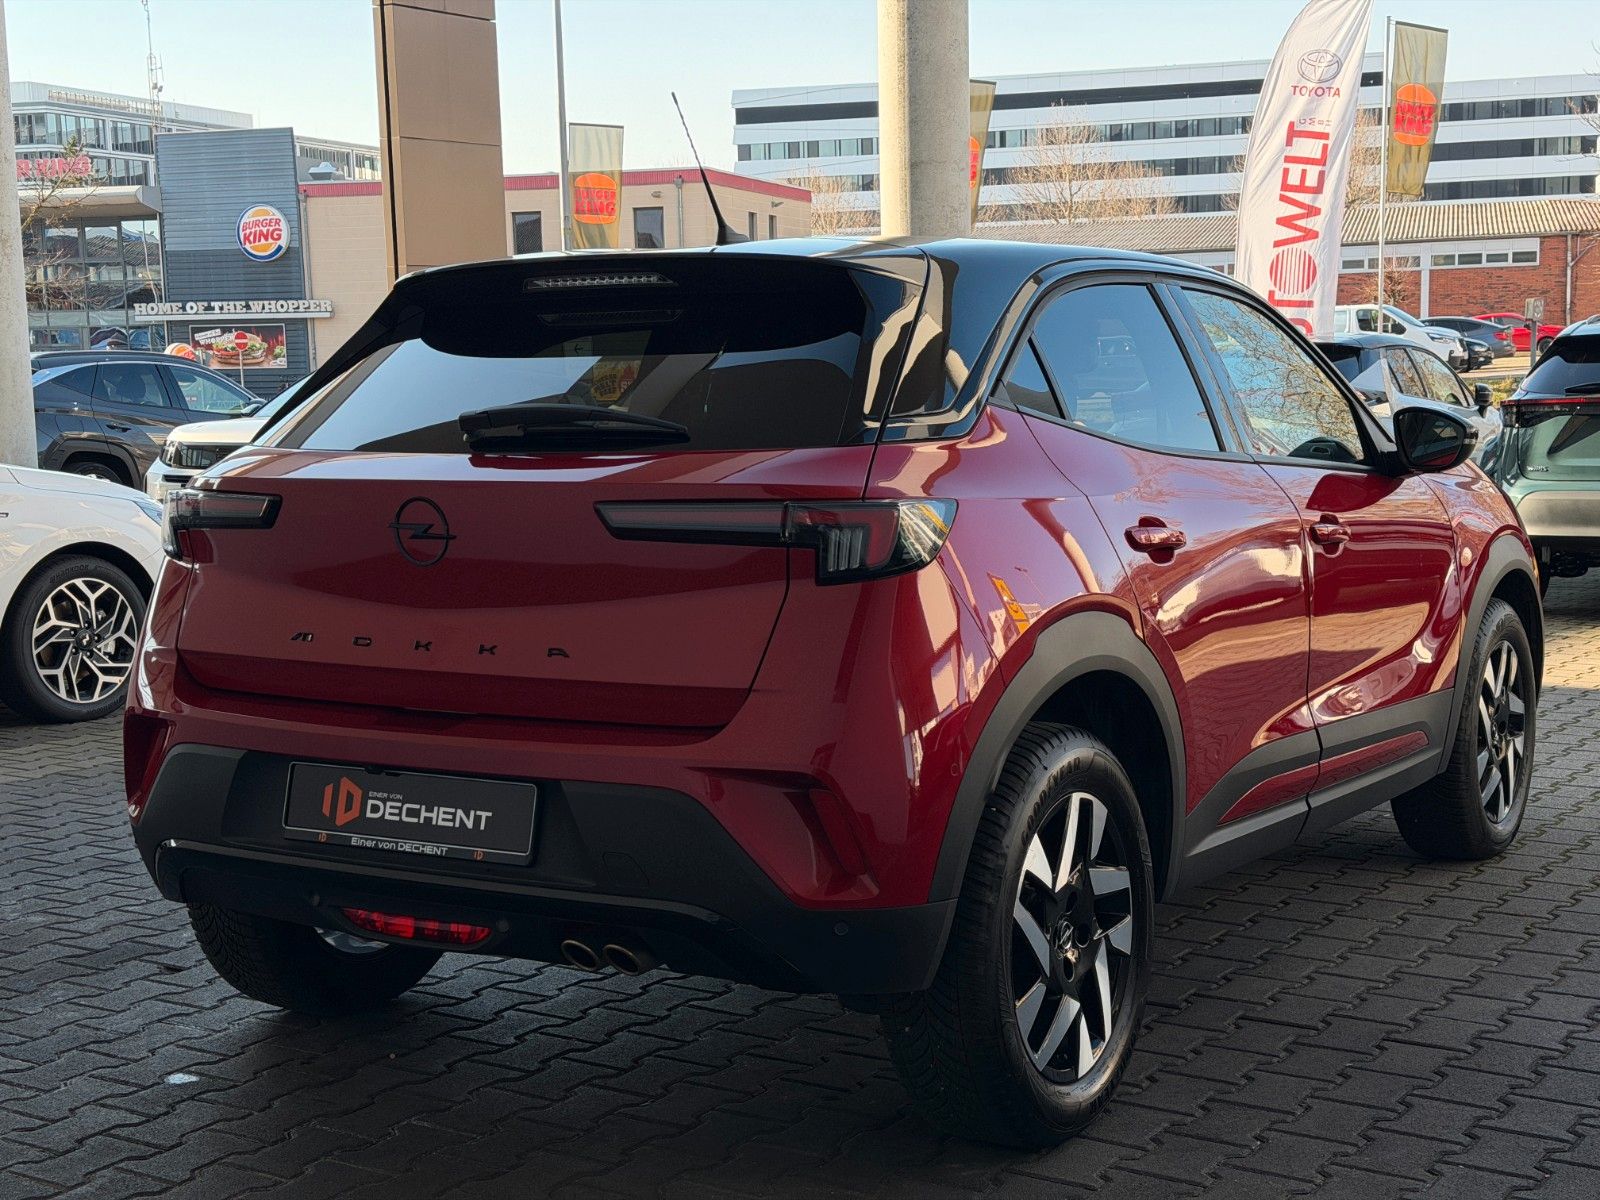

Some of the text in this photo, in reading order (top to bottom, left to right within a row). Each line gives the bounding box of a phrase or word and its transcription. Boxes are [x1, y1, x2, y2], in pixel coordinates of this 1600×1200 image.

[1291, 85, 1341, 98] TOYOTA
[242, 218, 281, 232] BURGER
[243, 228, 283, 246] KING
[133, 300, 333, 316] HOME OF THE WHOPPER
[290, 632, 570, 658] MOKKA
[369, 791, 388, 799] EINER
[366, 799, 493, 831] DECHENT
[351, 836, 448, 857] Einer von DECHENT
